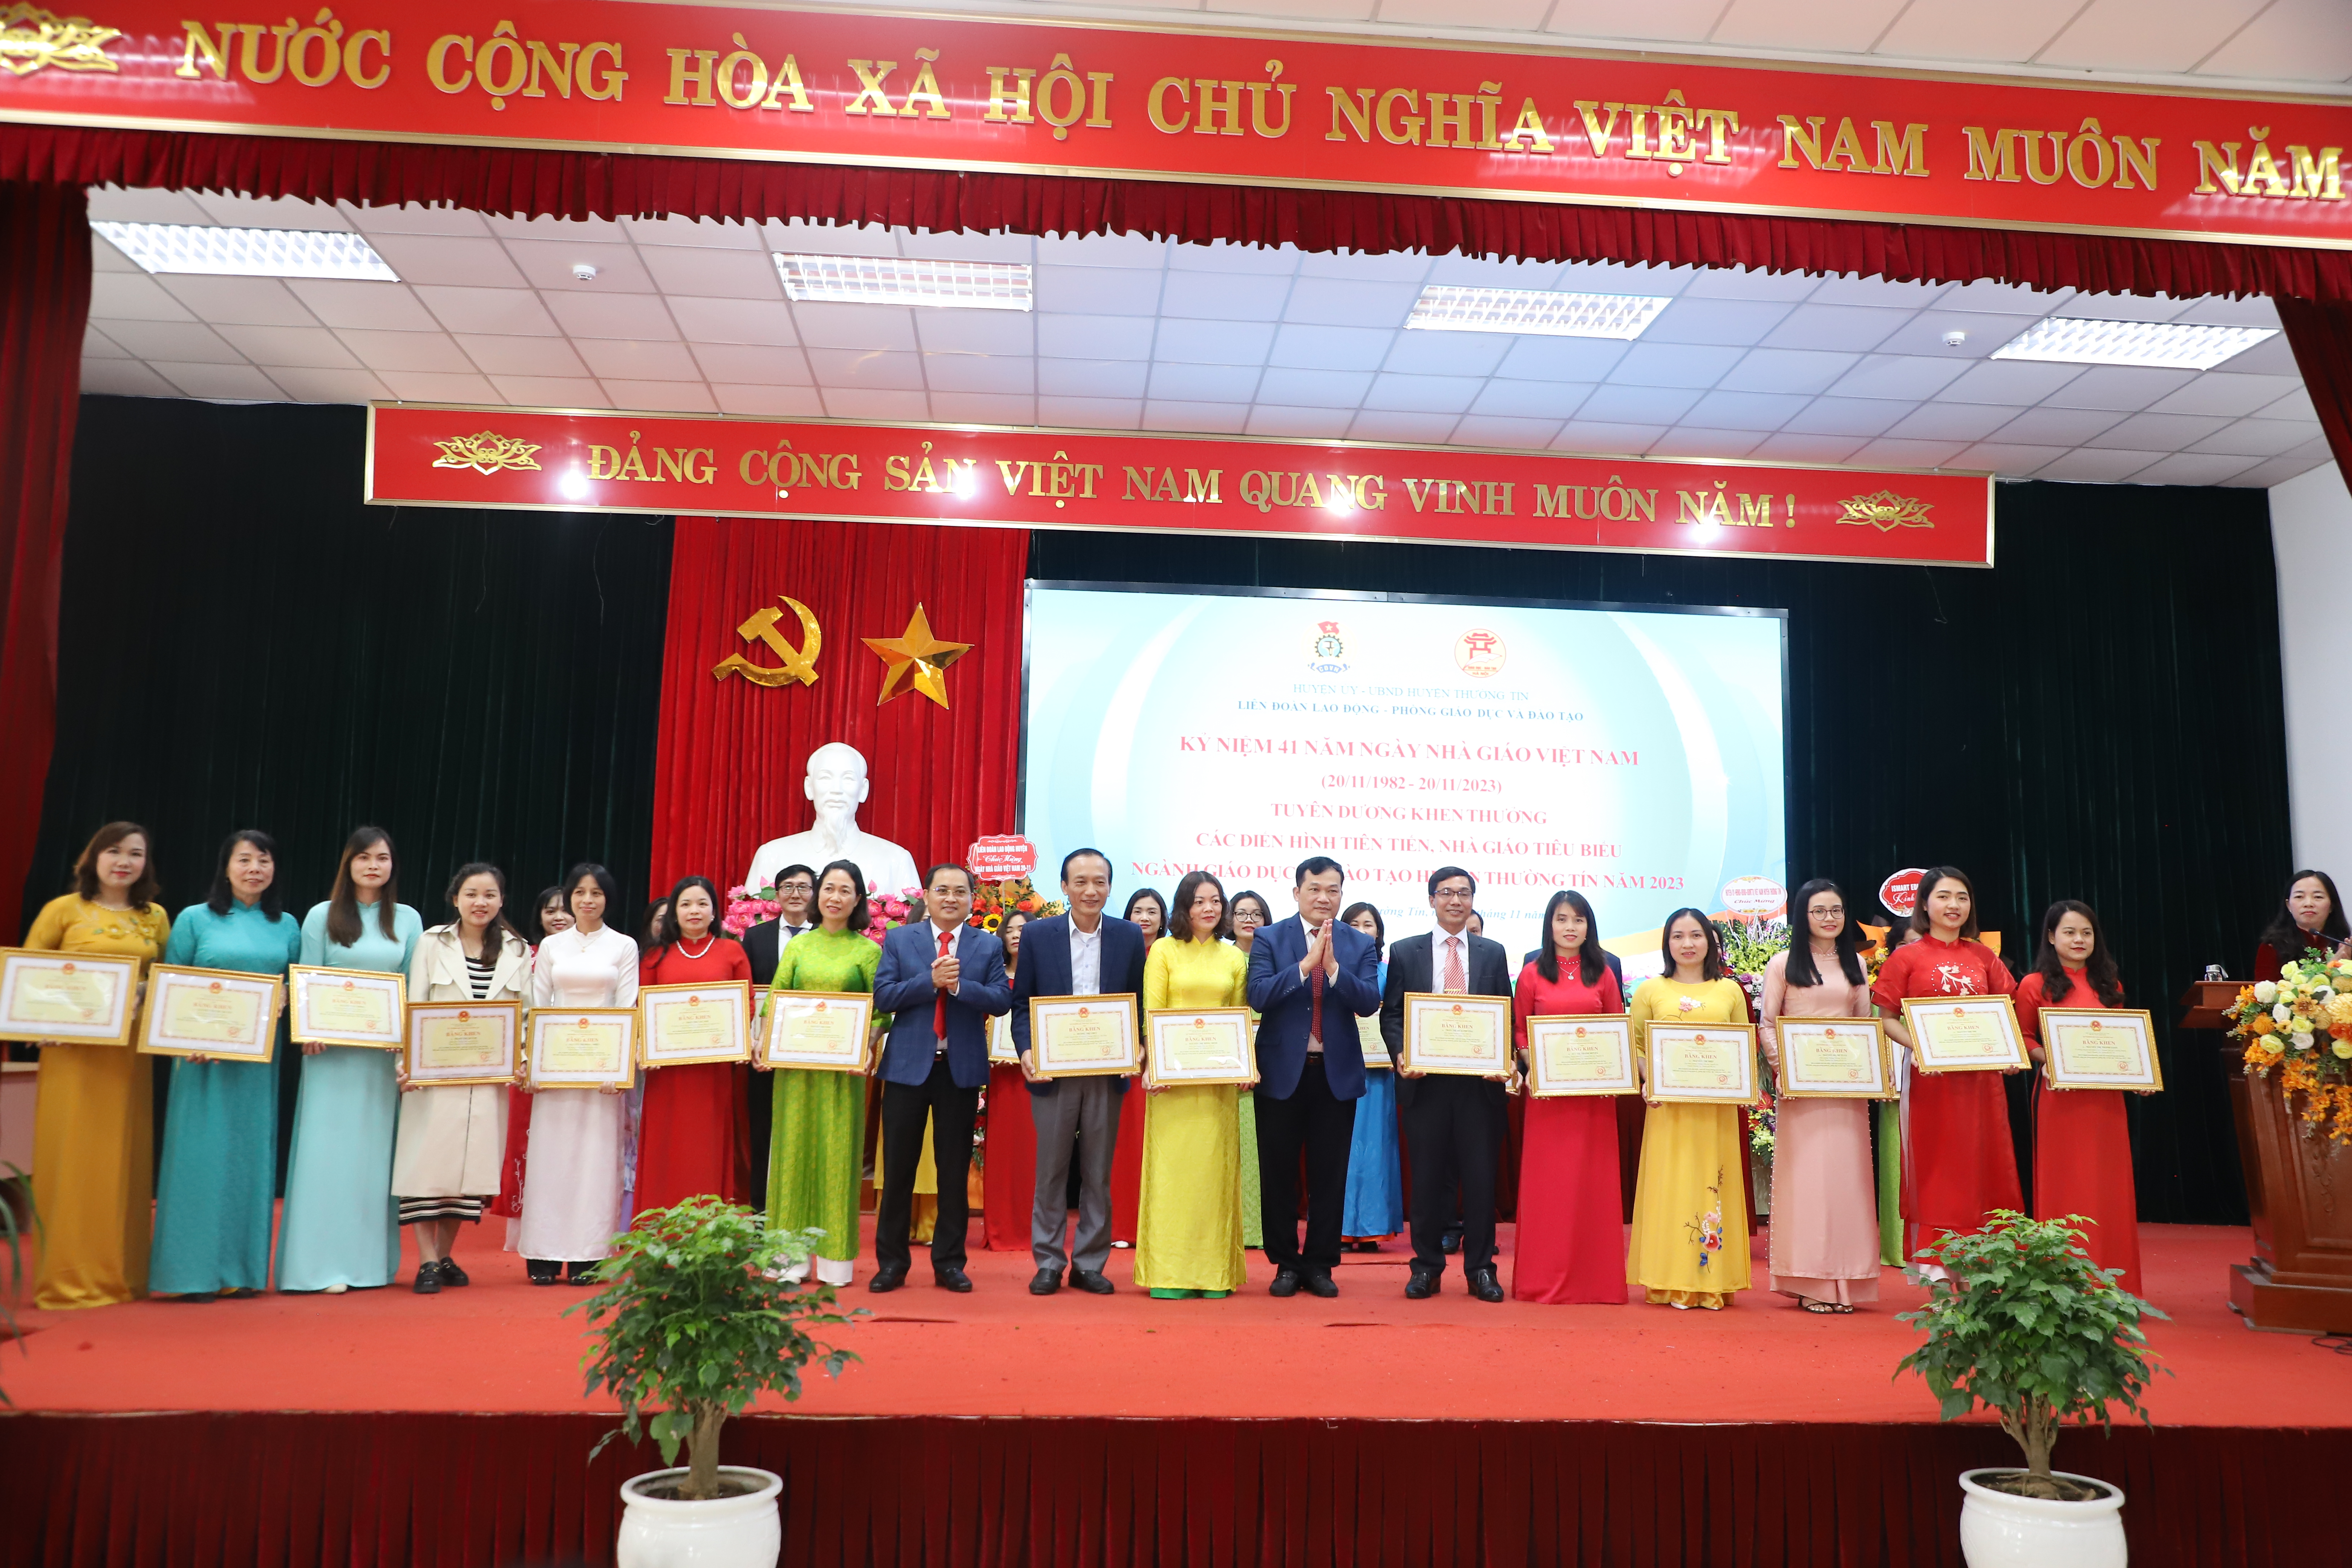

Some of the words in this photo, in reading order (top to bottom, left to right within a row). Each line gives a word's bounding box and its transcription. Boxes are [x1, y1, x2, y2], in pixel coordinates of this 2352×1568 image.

[175, 7, 390, 90] NƯỚC
[427, 20, 629, 111] CỘNG
[664, 32, 813, 113] HÒA
[845, 47, 951, 119] XÃ
[983, 53, 1114, 141] HỘI
[1147, 59, 1297, 139] CHỦ
[1325, 81, 1555, 153] NGHĨA
[1573, 88, 1739, 177] VIỆT
[1777, 114, 1930, 177] NAM
[1963, 117, 2161, 191] MUÔN
[2192, 126, 2346, 201] NĂM
[587, 430, 718, 484] ĐẢNG
[739, 439, 862, 499] CỘNG
[884, 441, 975, 497] SẢN
[995, 450, 1104, 508] VIỆT
[1121, 465, 1223, 504] NAM
[1240, 470, 1387, 513] QUANG
[1402, 478, 1516, 516] VINH
[1533, 475, 1660, 523] MUÔN
[1675, 481, 1776, 528] NĂM
[1785, 492, 1796, 528] !
[1294, 684, 1336, 695] HUYỆN
[1369, 687, 1403, 696] UBND
[1407, 688, 1450, 699] HUYỆN
[1454, 689, 1505, 700] THƯỜNG
[1238, 699, 1267, 710] LIÊN
[1272, 700, 1308, 711] ĐOÀN
[1312, 703, 1338, 712] LAO
[1344, 703, 1379, 715] ĐỘNG
[1392, 703, 1436, 716] PHÒNG
[1441, 706, 1471, 717] GIÁO
[1478, 709, 1503, 720] DỤC
[1508, 708, 1524, 719] VÀ
[1528, 709, 1554, 720] ĐÀO
[1558, 712, 1583, 723] TẠO
[1217, 735, 1272, 757] NIỆM
[1278, 740, 1297, 754] 41
[1304, 737, 1354, 756] NĂM
[1360, 738, 1421, 758] NGÀY
[1426, 741, 1472, 760] NHÀ
[1476, 742, 1531, 762] GIÁO
[1535, 746, 1585, 767] VIỆT
[1590, 750, 1639, 766] NAM
[1321, 775, 1406, 790] (20/11/1982
[1418, 777, 1502, 795] 20/11/2023)
[1271, 801, 1333, 818] TUYÊN
[1338, 804, 1406, 820] DƯƠNG
[1411, 807, 1463, 821] KHEN
[1466, 807, 1547, 824] THƯỞNG
[1015, 844, 1027, 853] HUYỆN
[1196, 830, 1236, 847] CÁC
[1289, 832, 1336, 850] HÌNH
[1341, 833, 1383, 851] TIÊN
[1387, 835, 1434, 853] TIẾN,
[1439, 836, 1478, 854] NHÀ
[1482, 838, 1528, 855] GIÁO
[1533, 839, 1574, 857] TIÊU
[1580, 841, 1622, 858] BIỂU
[1204, 861, 1251, 878] GIÁO
[1257, 866, 1295, 882] DỤC
[1344, 864, 1369, 881] ÀO
[1374, 869, 1412, 885] TẠO
[1484, 868, 1565, 887] THƯỜNG
[1568, 870, 1598, 888] TÍN
[1603, 872, 1645, 890] NĂM
[1649, 876, 1684, 890] 2023
[1377, 907, 1403, 917] ường
[1510, 910, 1520, 919] 11
